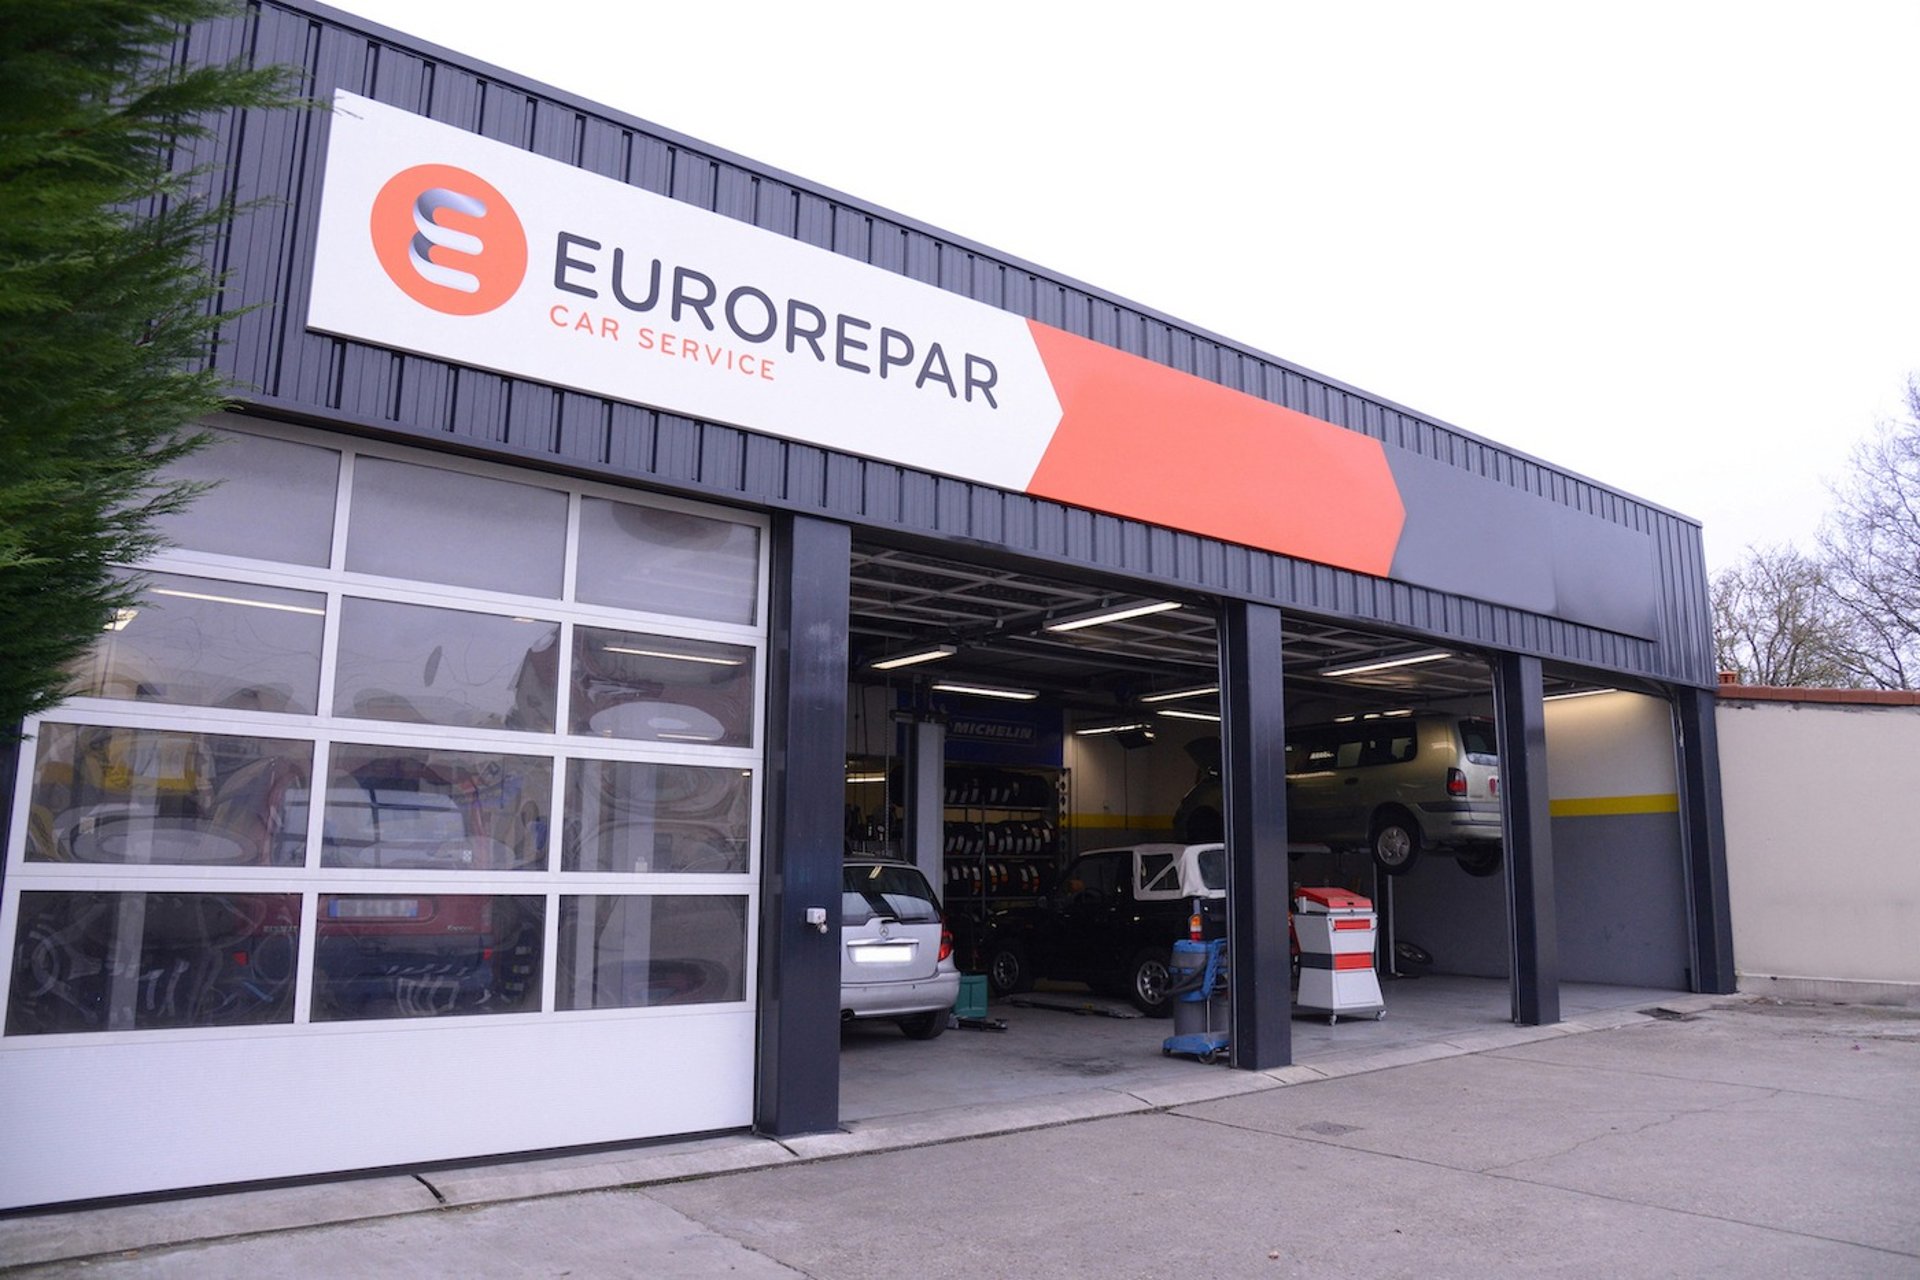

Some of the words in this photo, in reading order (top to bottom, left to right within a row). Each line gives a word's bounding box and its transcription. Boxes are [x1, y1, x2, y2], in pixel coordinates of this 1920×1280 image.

[549, 304, 620, 342] CAR
[638, 327, 775, 381] SERVICE
[553, 230, 999, 410] EUROREPAR
[954, 722, 1033, 738] MICHELIN
